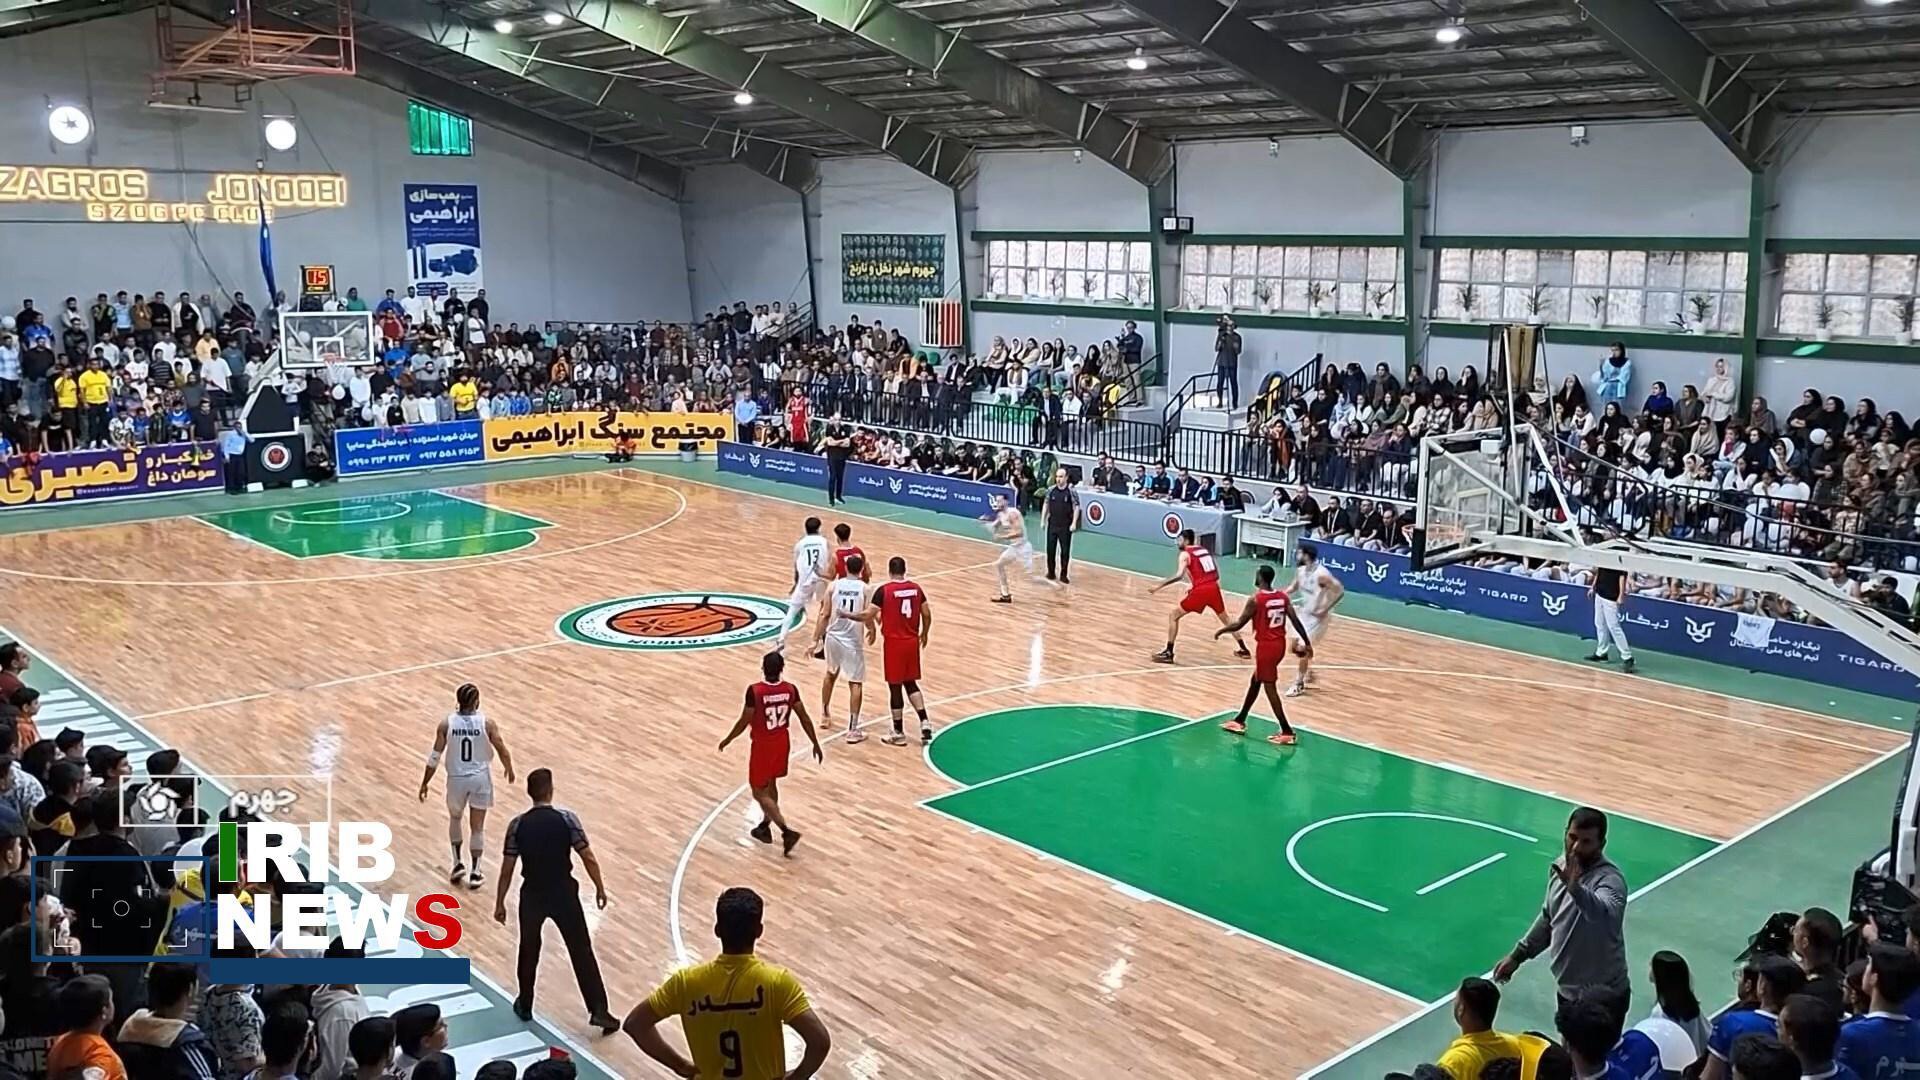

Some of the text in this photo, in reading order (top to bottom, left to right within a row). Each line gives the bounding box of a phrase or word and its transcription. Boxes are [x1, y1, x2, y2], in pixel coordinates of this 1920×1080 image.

[0, 167, 346, 206] ZAGROS JONOOBI
[409, 205, 475, 224] ابراهیمی
[848, 262, 936, 278] جهرم شهر نخل و نارنج
[492, 412, 726, 452] مجتمع سنگ ابراهیمی
[0, 452, 138, 504] نصیری
[147, 468, 217, 487] سوهان داغ
[806, 549, 820, 567] 13
[1479, 587, 1529, 603] TIGARD
[901, 598, 913, 619] 4
[1766, 645, 1820, 663] تیم های ملی
[1837, 653, 1906, 673] TIGARD
[765, 704, 789, 731] 32
[461, 736, 472, 762] 0
[687, 984, 764, 1016] لیدر
